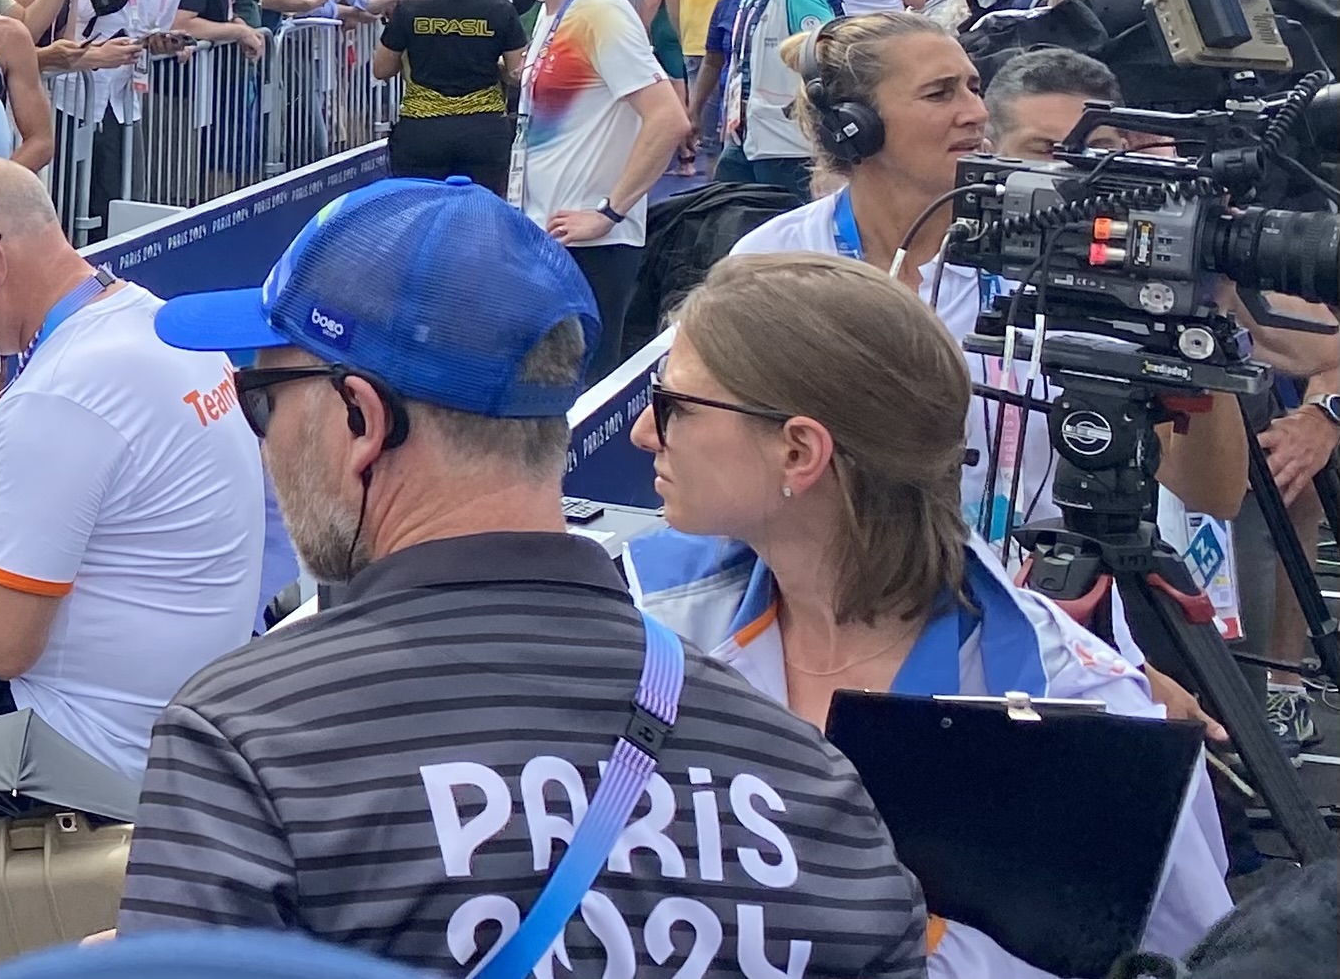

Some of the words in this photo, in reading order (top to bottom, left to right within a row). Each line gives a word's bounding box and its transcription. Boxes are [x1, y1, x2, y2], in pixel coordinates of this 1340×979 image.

[414, 17, 495, 36] BRASIL
[189, 223, 207, 242] 2024
[143, 242, 162, 261] 2024
